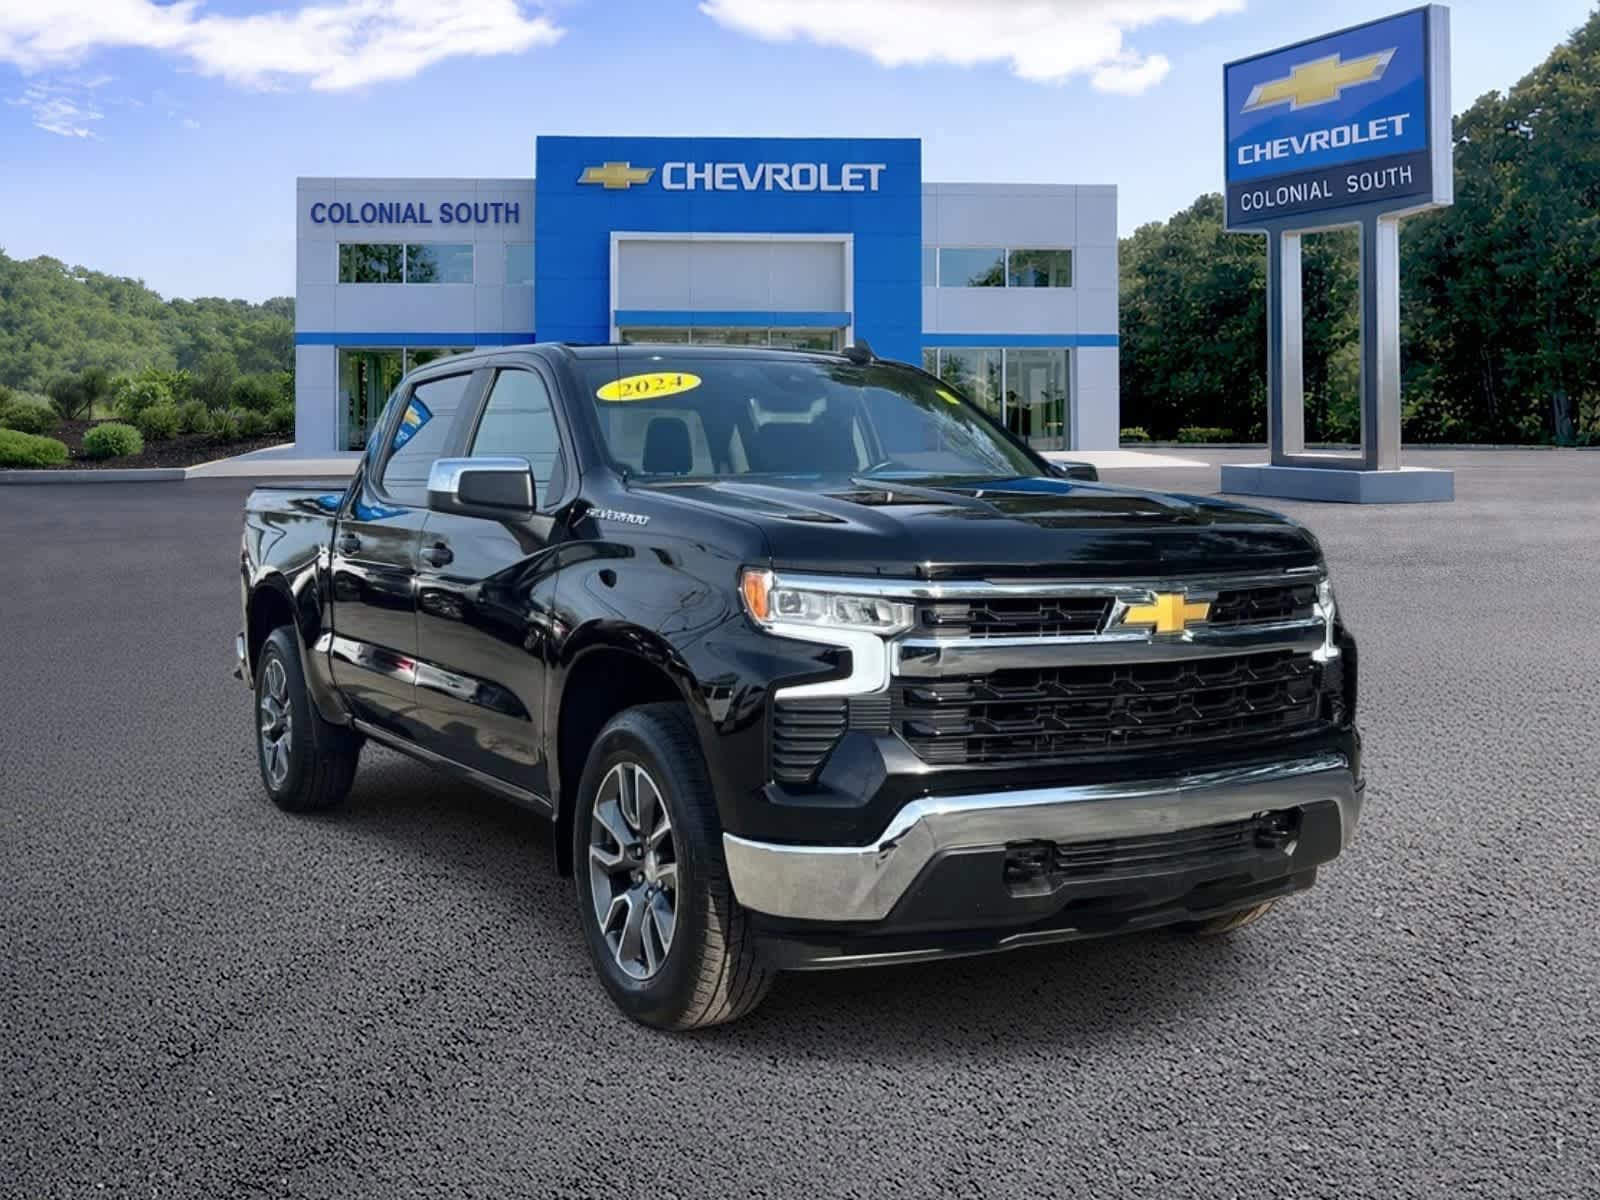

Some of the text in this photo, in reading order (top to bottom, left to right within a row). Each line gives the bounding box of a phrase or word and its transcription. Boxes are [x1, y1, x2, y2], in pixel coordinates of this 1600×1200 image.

[1237, 113, 1411, 166] CHEVROLET
[661, 161, 887, 192] CHEVROLET
[1240, 164, 1413, 212] COLONIAL SOUTH
[310, 202, 520, 224] COLONIAL SOUTH
[621, 375, 682, 397] 2024
